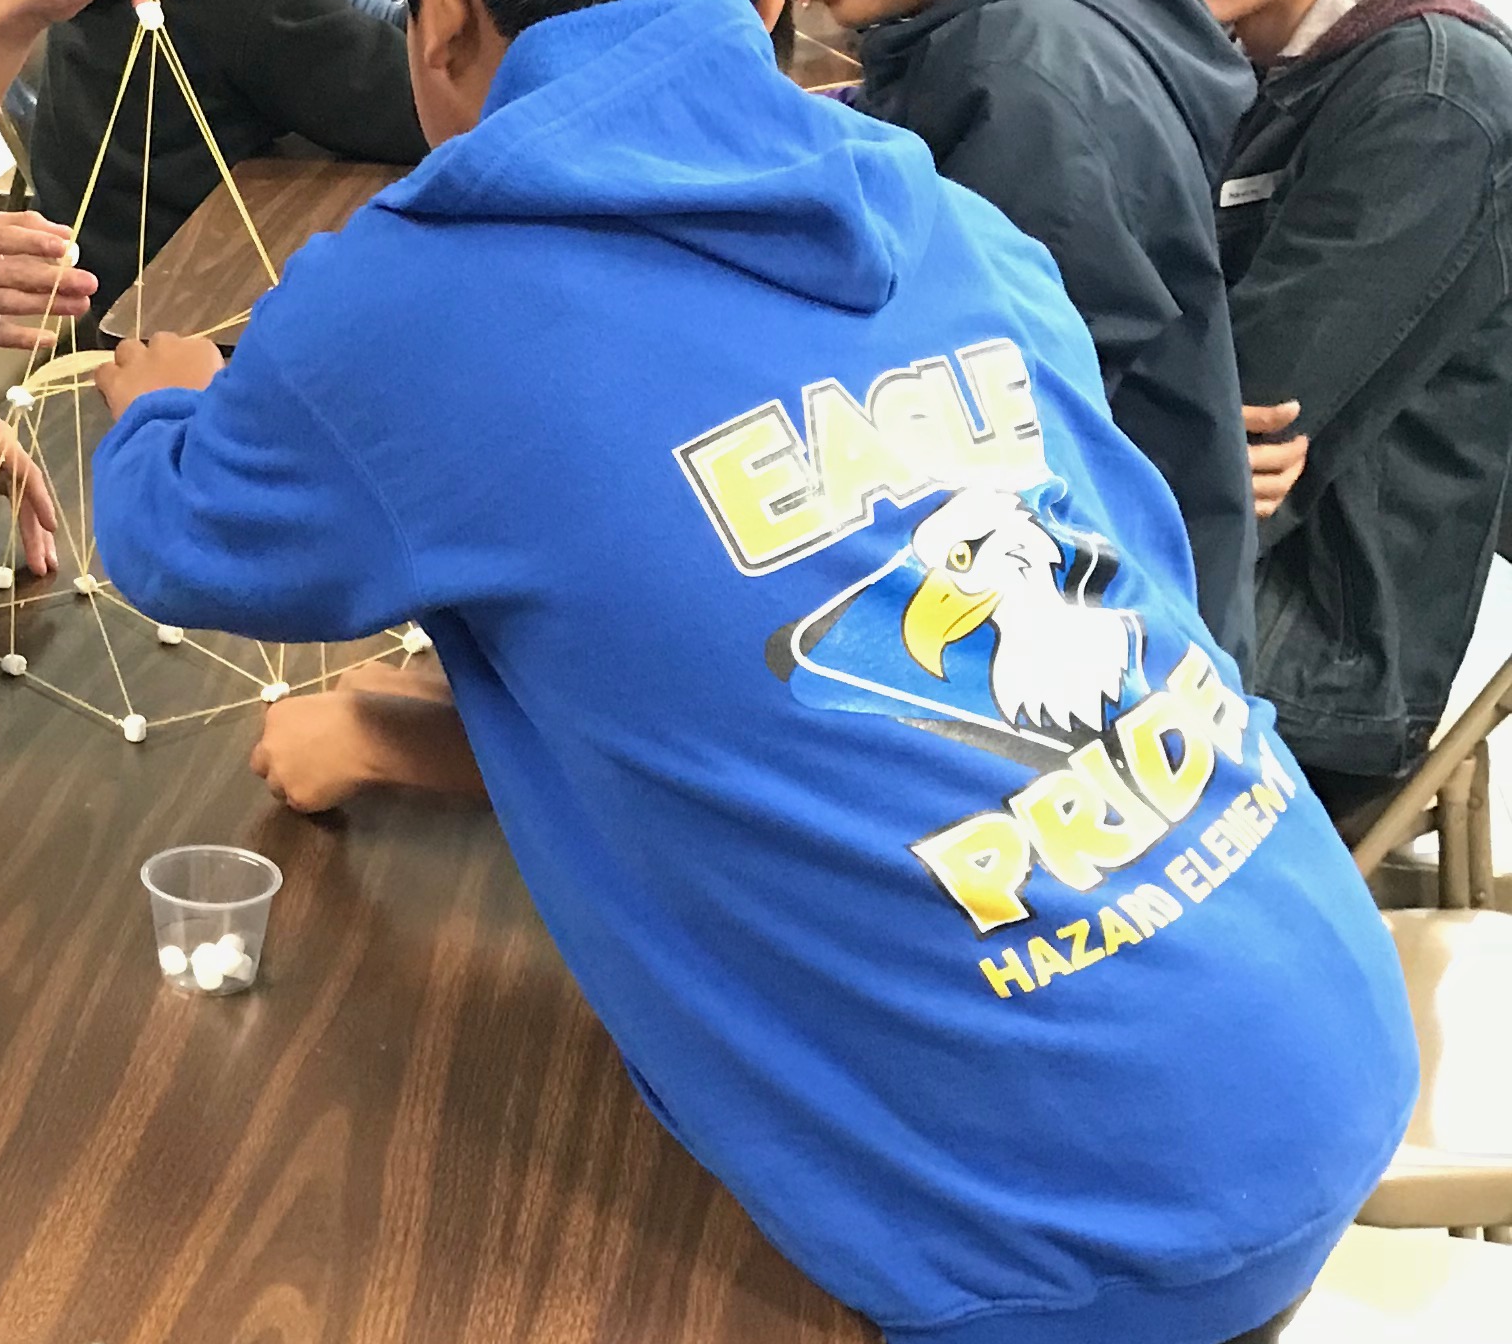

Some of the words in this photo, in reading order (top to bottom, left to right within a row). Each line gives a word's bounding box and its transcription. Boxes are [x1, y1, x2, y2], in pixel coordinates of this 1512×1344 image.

[672, 338, 1046, 578] EAGLE
[911, 641, 1250, 936] PRIDE
[979, 883, 1184, 998] HAZARD
